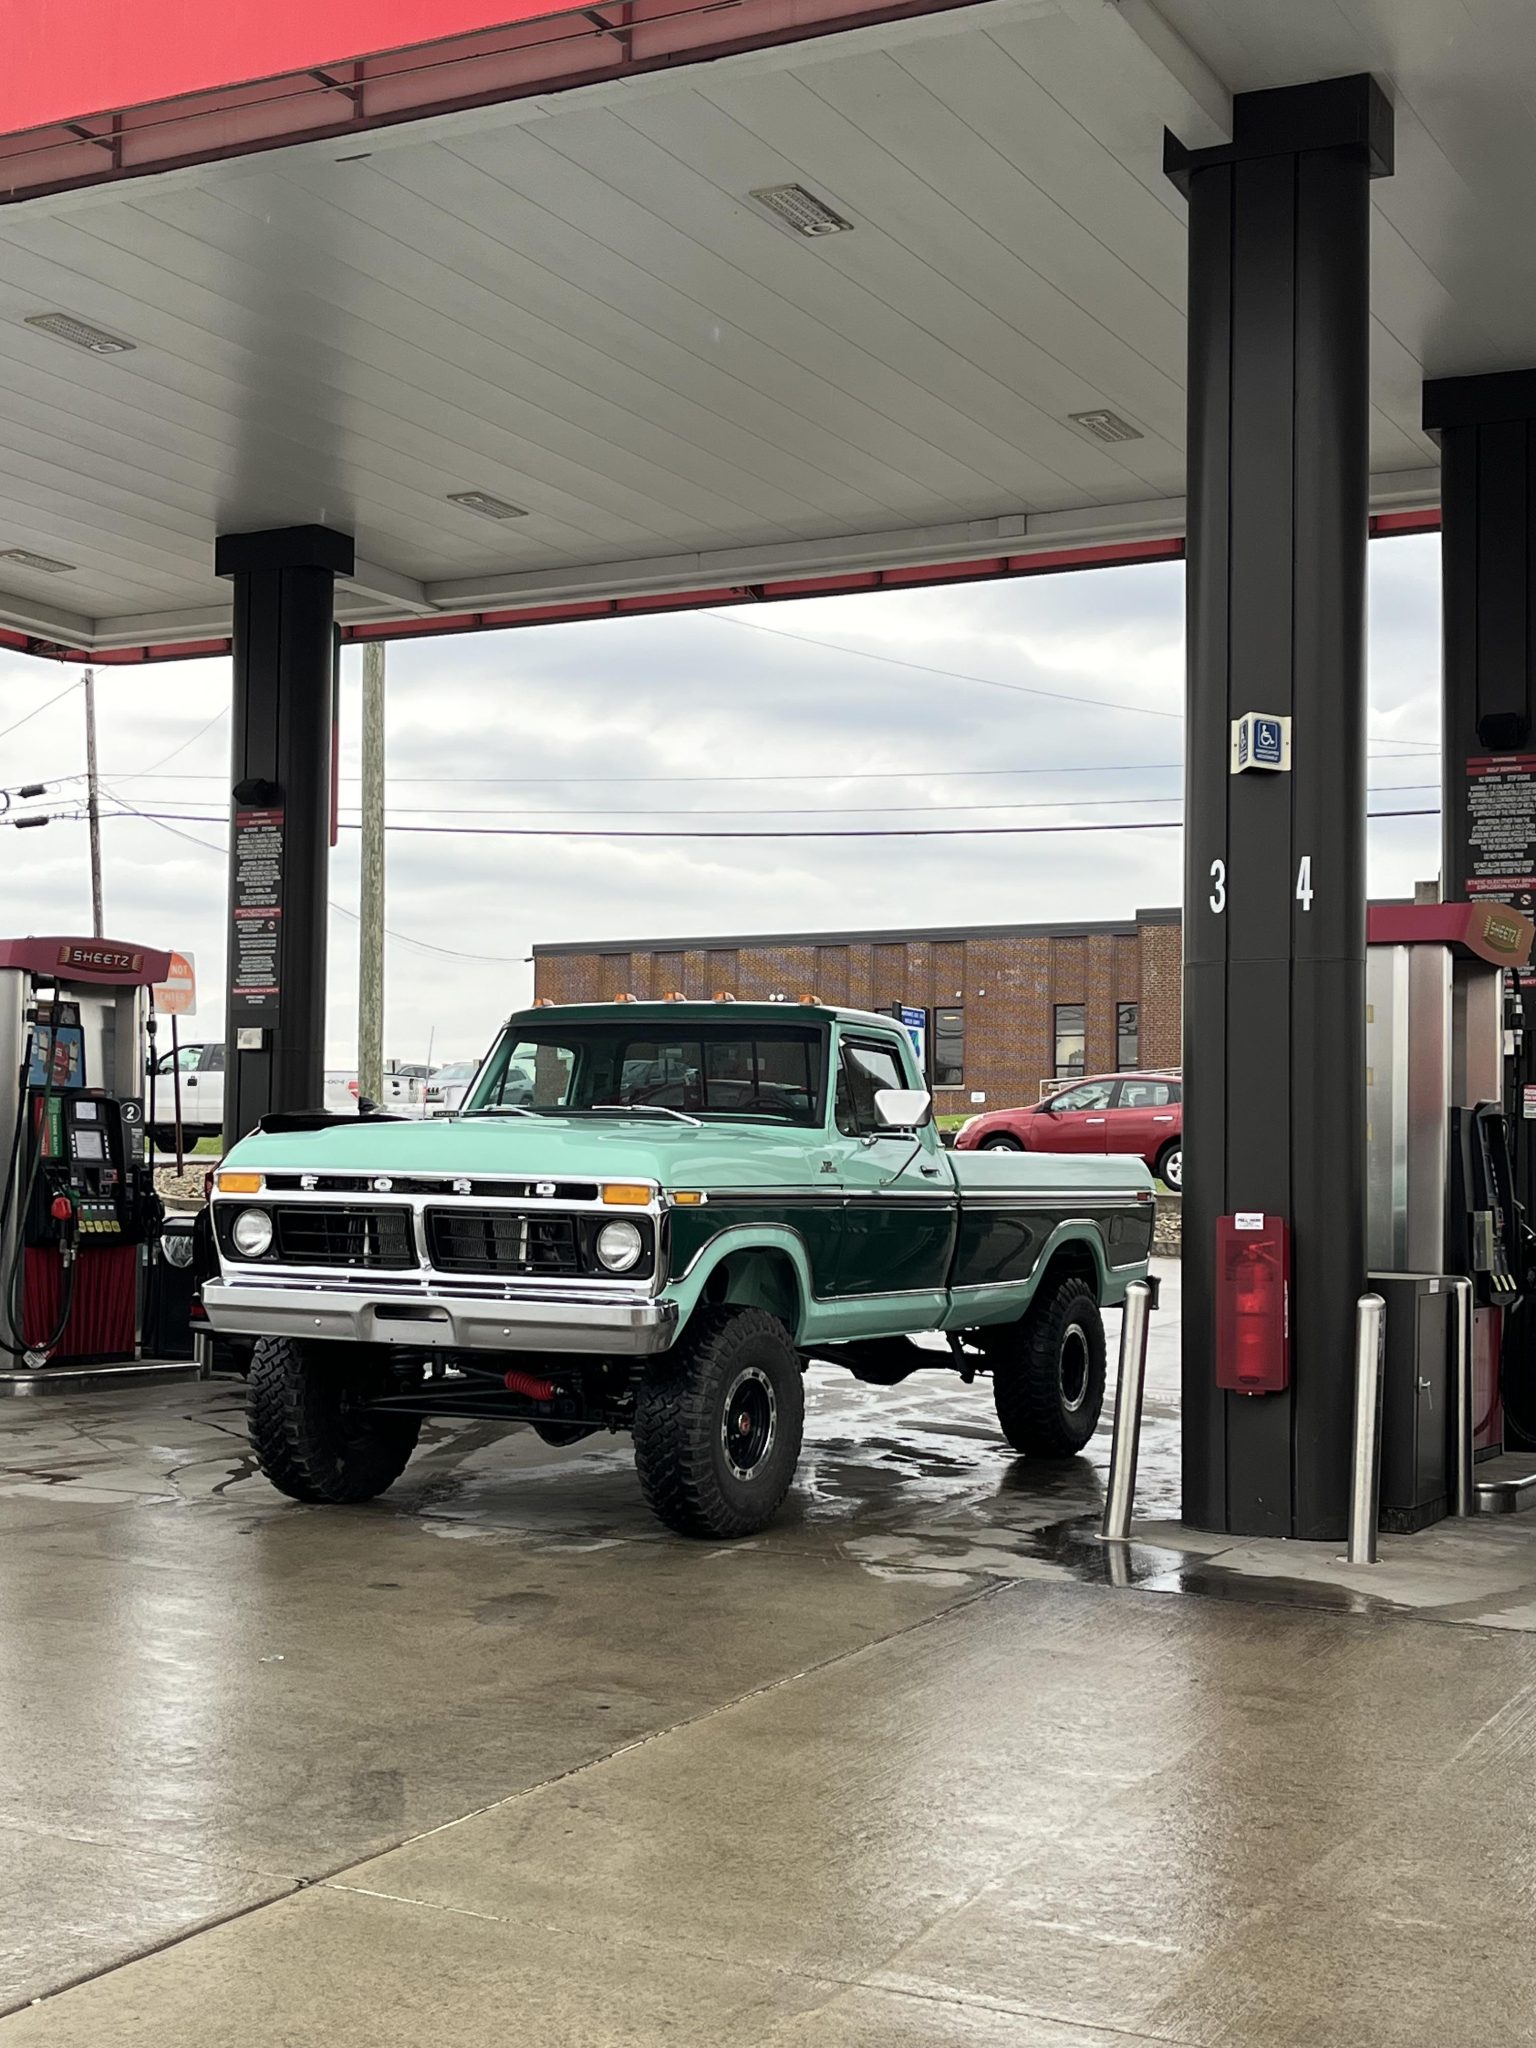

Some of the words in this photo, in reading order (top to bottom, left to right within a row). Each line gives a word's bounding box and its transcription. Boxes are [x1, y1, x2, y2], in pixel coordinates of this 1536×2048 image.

[1209, 859, 1226, 913] 3
[1296, 855, 1313, 911] 4
[1490, 921, 1516, 943] SHEETZ
[73, 950, 129, 966] SHEETZ
[172, 964, 188, 972] NOT
[126, 1106, 135, 1120] 2
